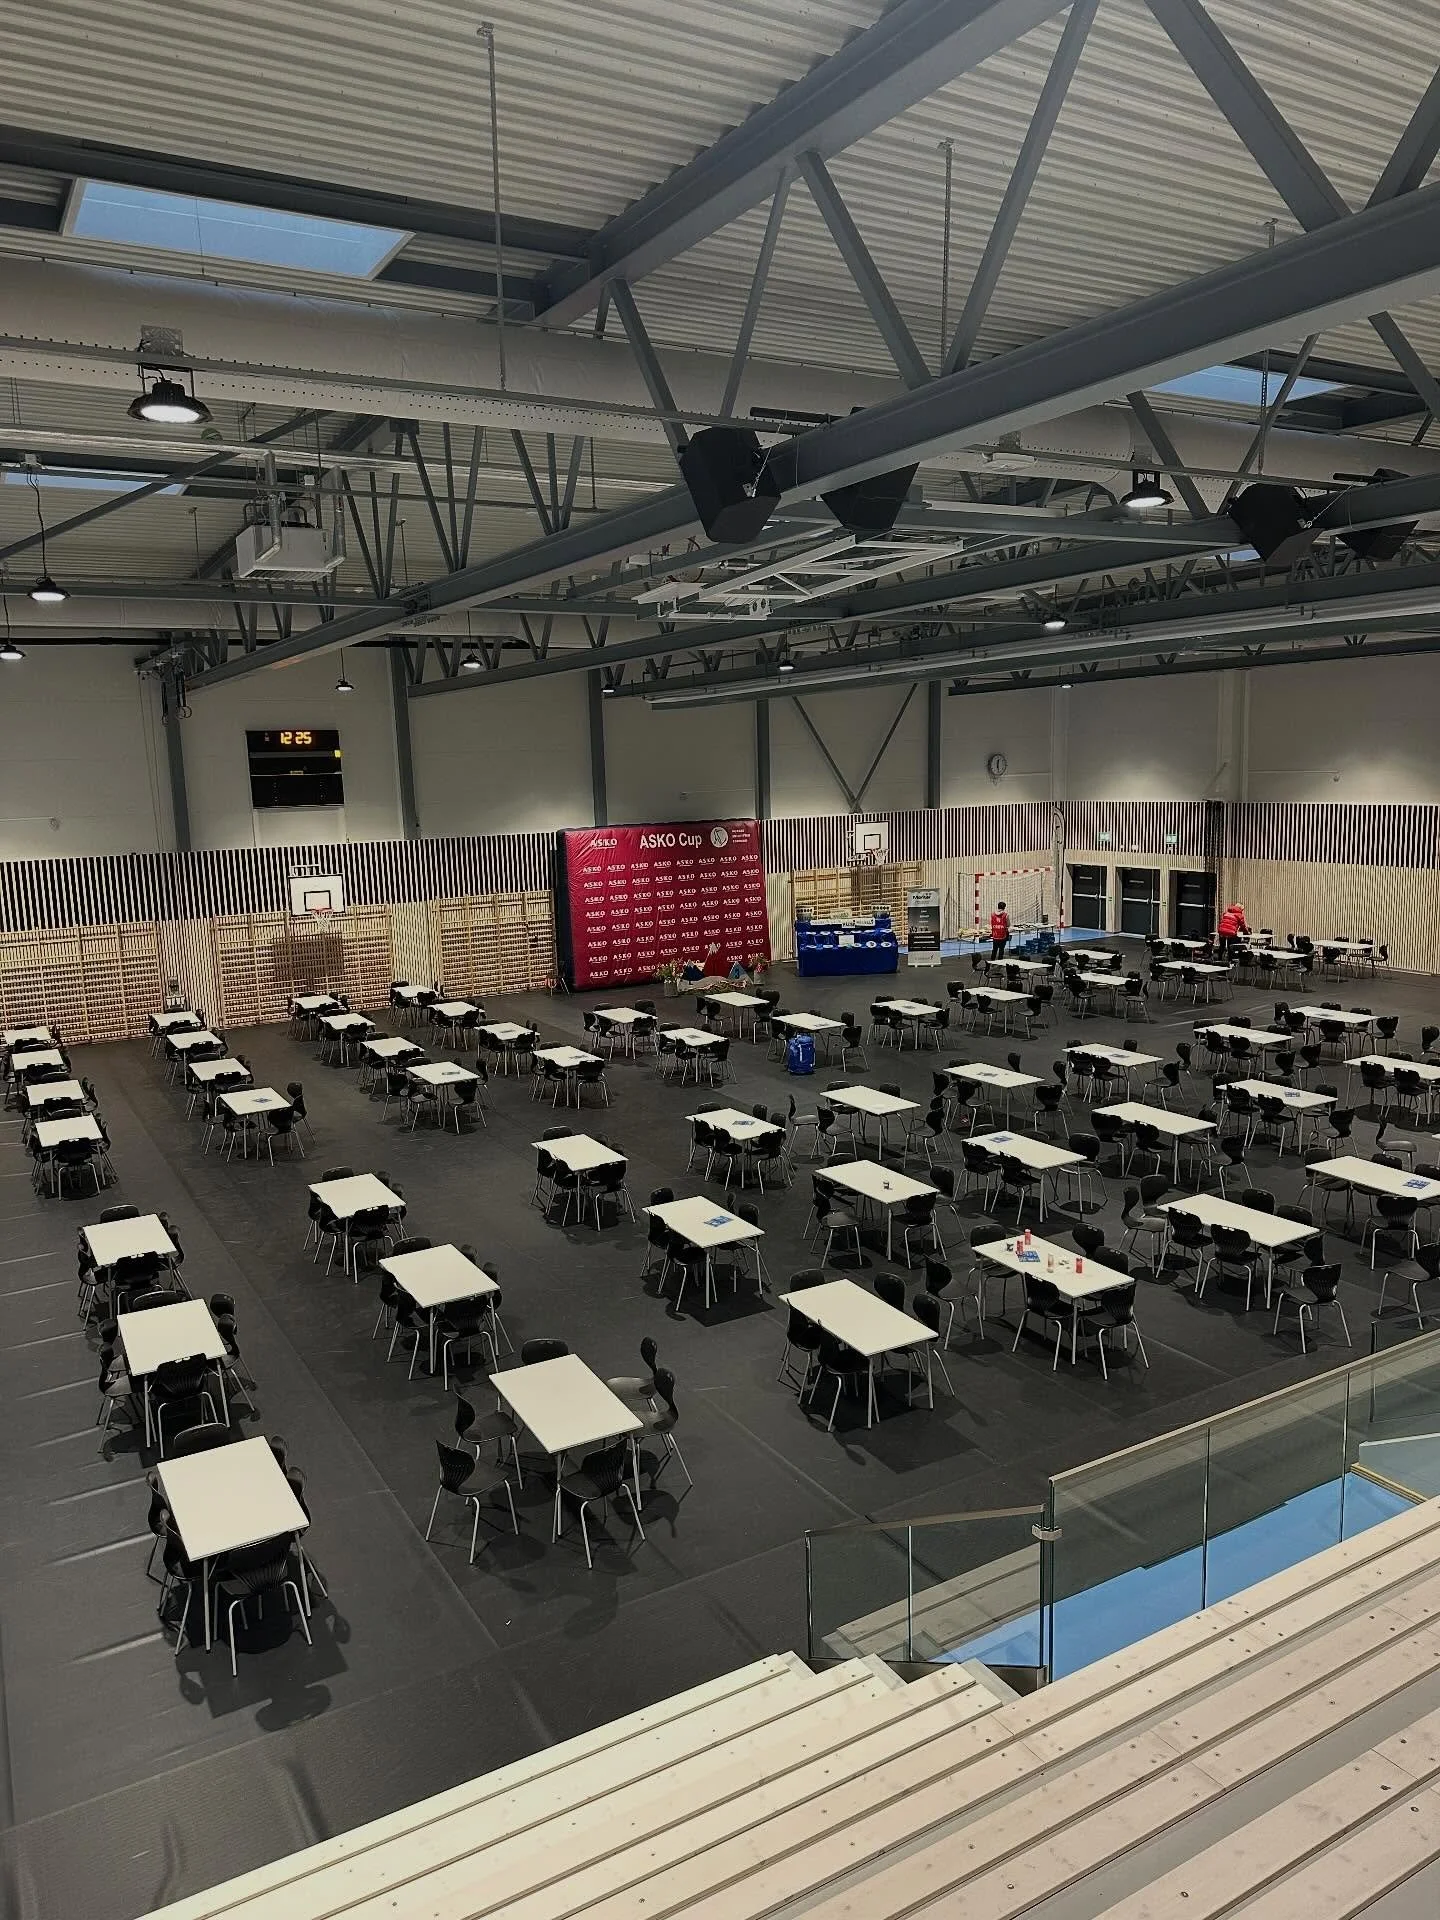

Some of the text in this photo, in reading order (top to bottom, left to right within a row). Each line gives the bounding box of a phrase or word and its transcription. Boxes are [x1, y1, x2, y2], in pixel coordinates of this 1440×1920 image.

[590, 838, 617, 848] ASKO
[640, 833, 702, 849] ASKO Cup
